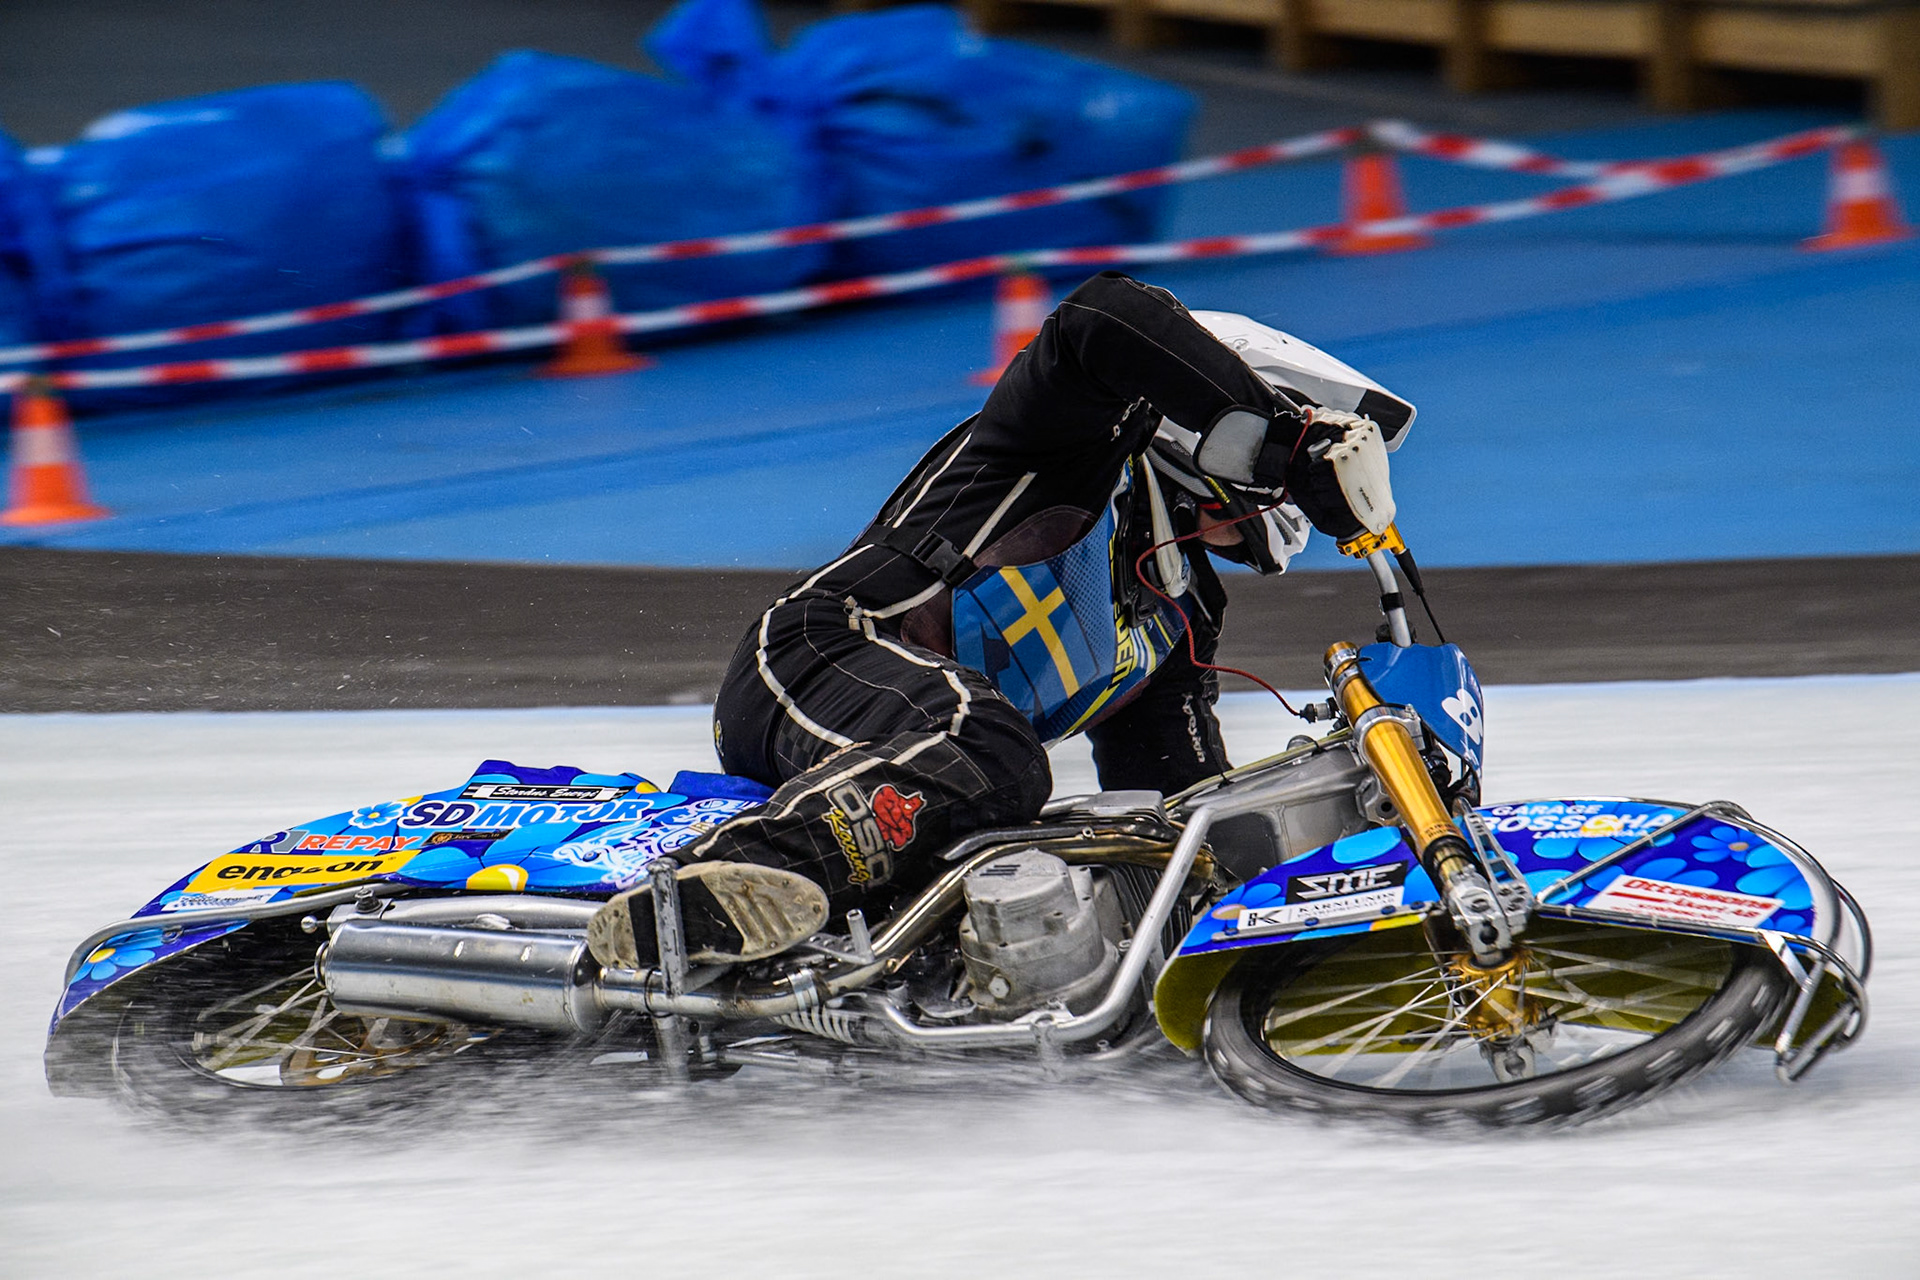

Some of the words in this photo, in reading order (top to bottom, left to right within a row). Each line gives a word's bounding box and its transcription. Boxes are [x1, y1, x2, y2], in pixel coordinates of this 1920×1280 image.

[1492, 804, 1604, 816] GARAGE
[297, 835, 418, 850] REPAY
[826, 808, 871, 883] Racing
